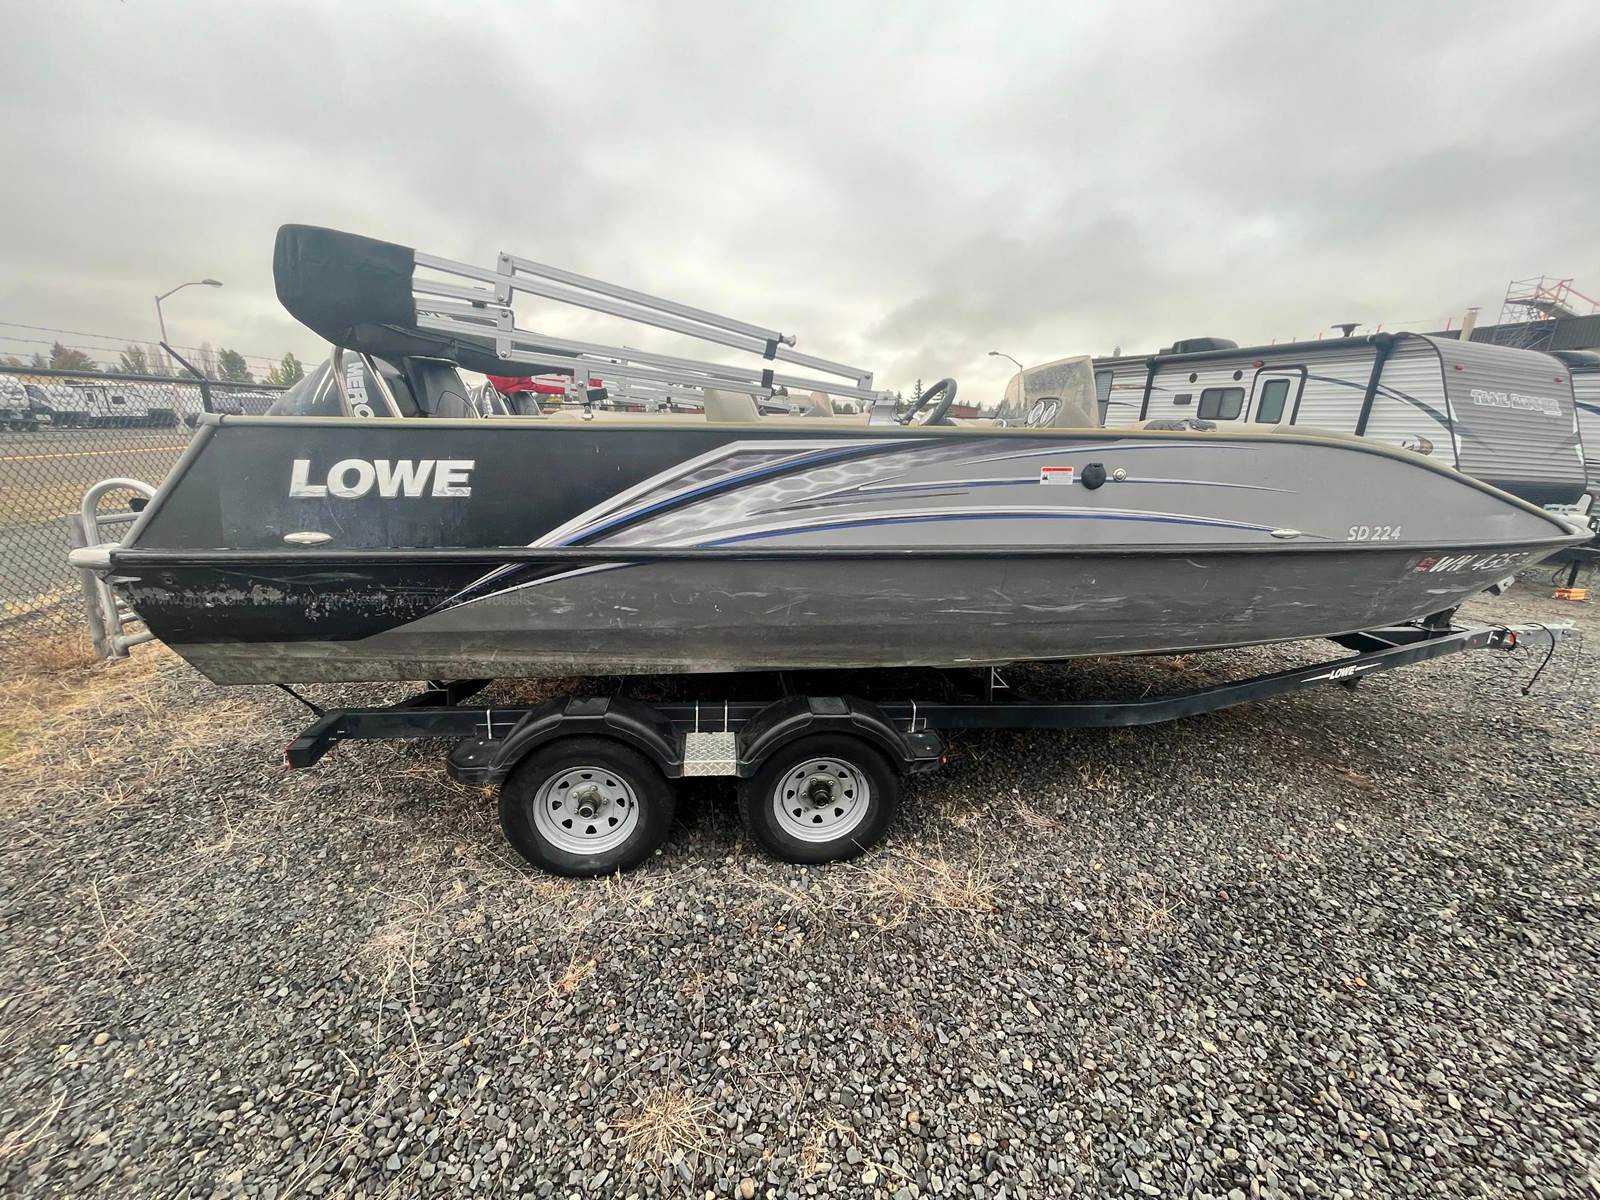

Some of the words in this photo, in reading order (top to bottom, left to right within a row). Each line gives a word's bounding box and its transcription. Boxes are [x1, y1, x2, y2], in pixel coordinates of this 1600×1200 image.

[1470, 389, 1510, 408] TRAIL
[289, 458, 476, 498] LOWE
[1347, 526, 1370, 541] SD
[1371, 526, 1402, 541] 224
[1329, 665, 1357, 680] LOWE
